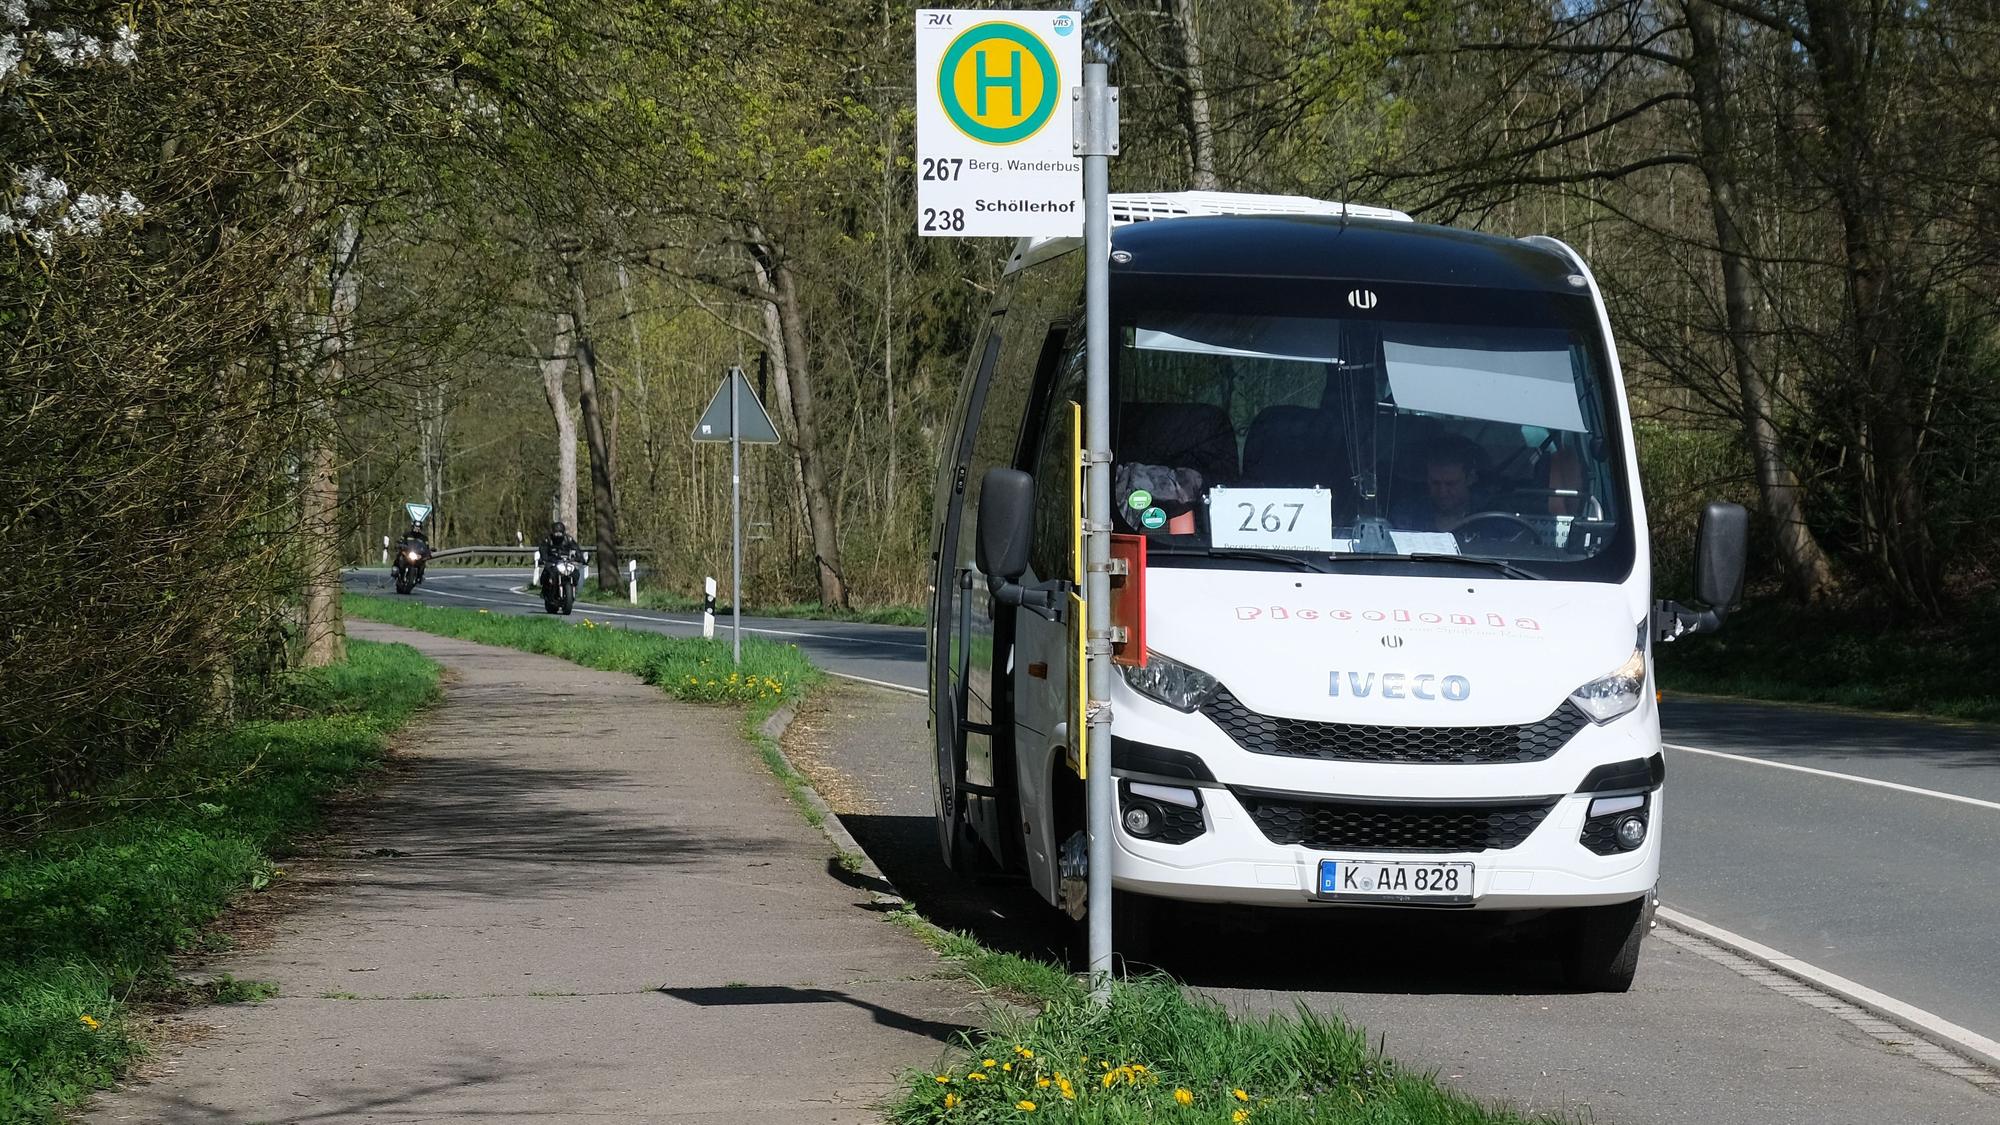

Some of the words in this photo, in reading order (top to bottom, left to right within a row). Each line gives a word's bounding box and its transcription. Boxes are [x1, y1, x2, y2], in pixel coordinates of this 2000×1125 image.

[1052, 19, 1069, 27] VRS
[975, 50, 1022, 117] H
[922, 158, 964, 181] 267
[969, 159, 1003, 173] Berg.
[1007, 159, 1080, 172] Wanderbus
[975, 199, 1076, 213] Schöllerhof
[923, 208, 965, 232] 238
[1237, 502, 1305, 533] 267
[1235, 605, 1541, 631] Piccolonia
[1328, 670, 1471, 701] IVECO
[1344, 866, 1359, 890] K
[1377, 867, 1408, 891] AA
[1414, 868, 1458, 891] 828
